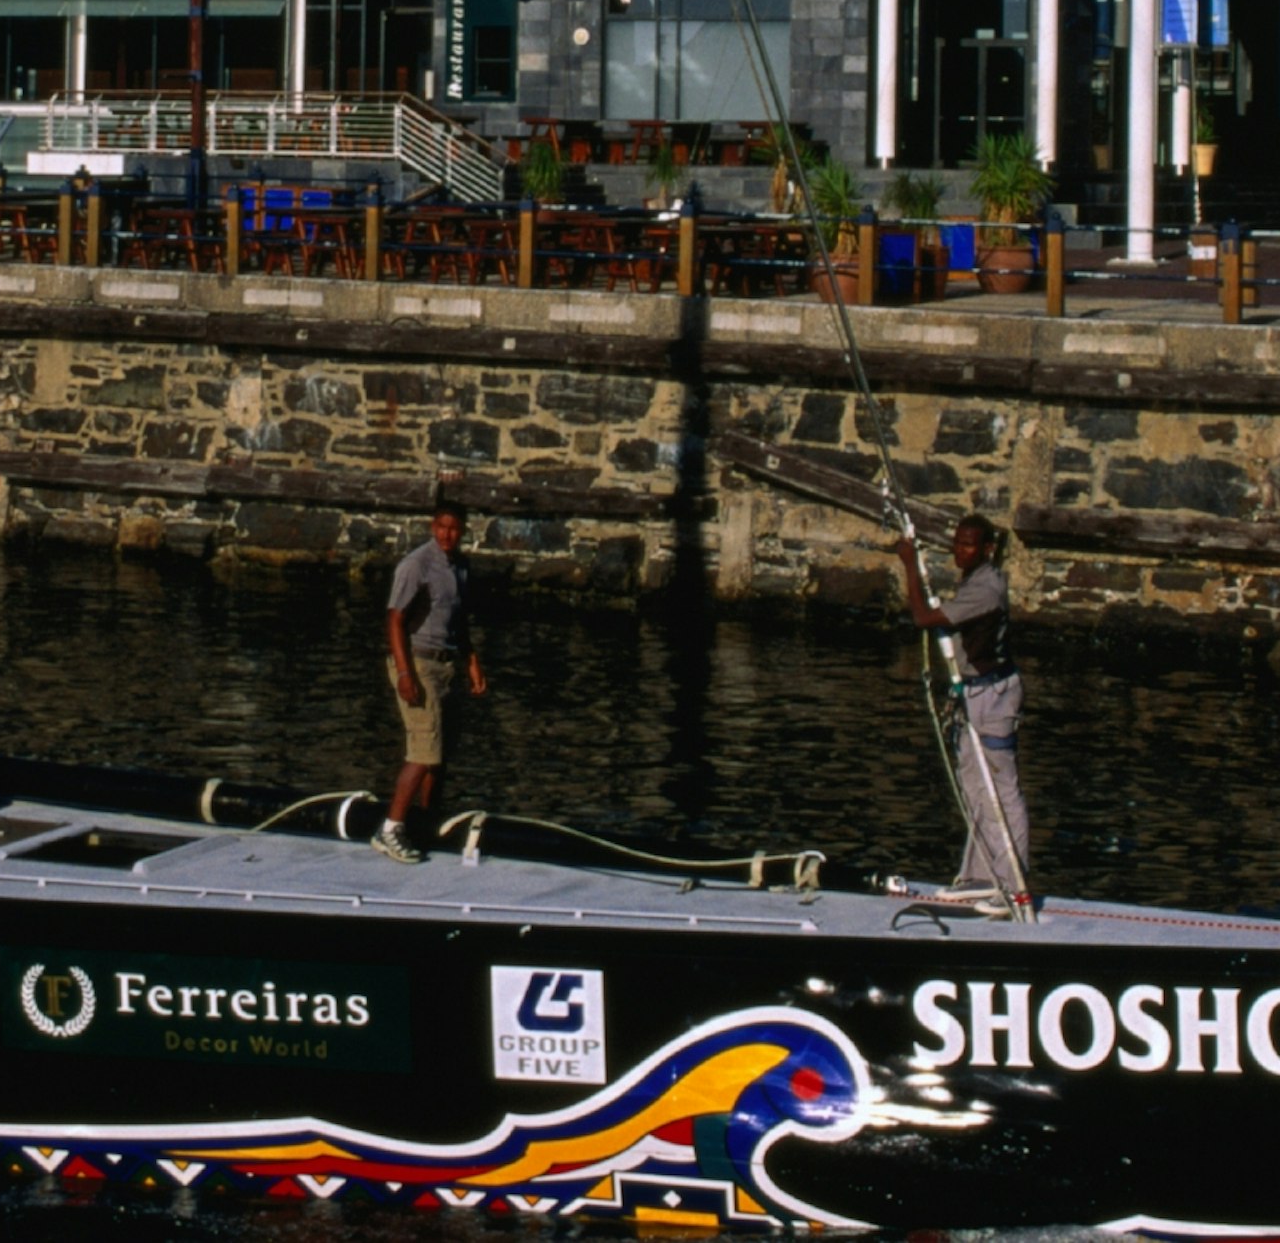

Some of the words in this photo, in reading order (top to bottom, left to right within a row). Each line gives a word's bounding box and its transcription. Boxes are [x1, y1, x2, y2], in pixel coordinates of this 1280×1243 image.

[114, 971, 370, 1026] Ferreiras
[164, 1031, 238, 1053] Decor
[249, 1034, 328, 1058] World
[499, 1034, 600, 1056] GROUP
[518, 1057, 582, 1077] FIVE
